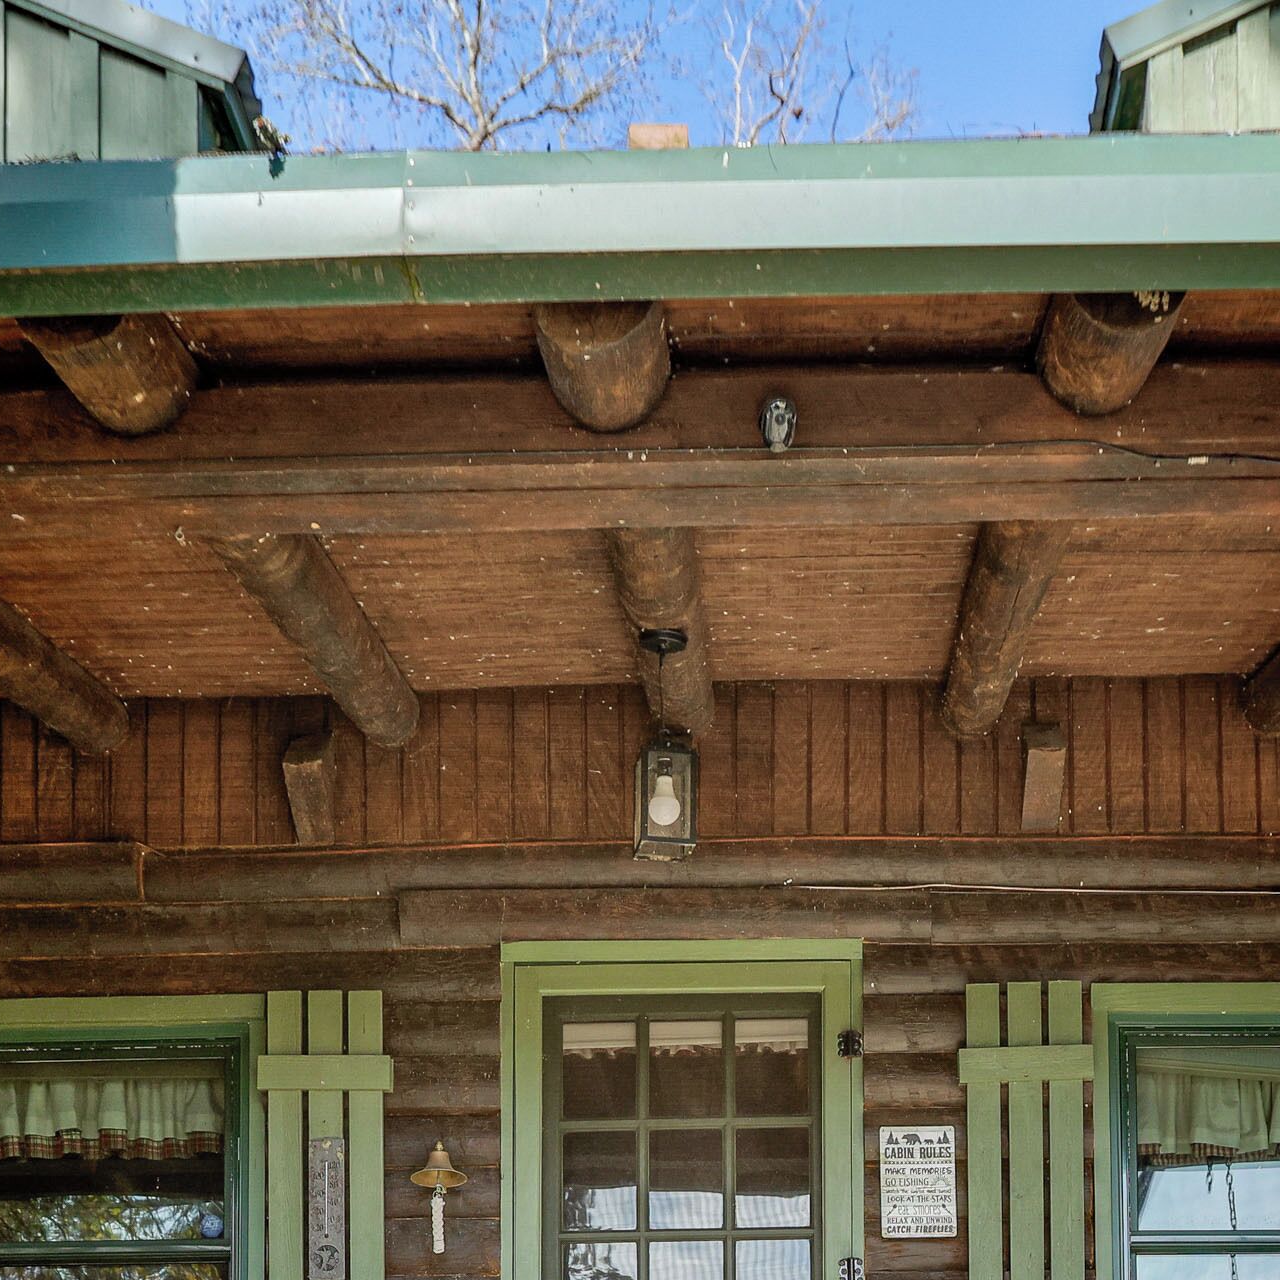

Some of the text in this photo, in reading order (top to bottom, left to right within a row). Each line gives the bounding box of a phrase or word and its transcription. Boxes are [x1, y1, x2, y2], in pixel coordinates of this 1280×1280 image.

[884, 1146, 952, 1159] CABIN RULES
[910, 1167, 952, 1175] MEMORIES
[886, 1178, 929, 1187] GO FISHING
[888, 1195, 904, 1204] LOOK
[906, 1195, 914, 1203] AT
[932, 1195, 952, 1203] STARS
[898, 1205, 910, 1215] eat
[886, 1216, 952, 1224] RELAX AND UNWIND
[886, 1224, 954, 1234] CATCH FIREFLIES
